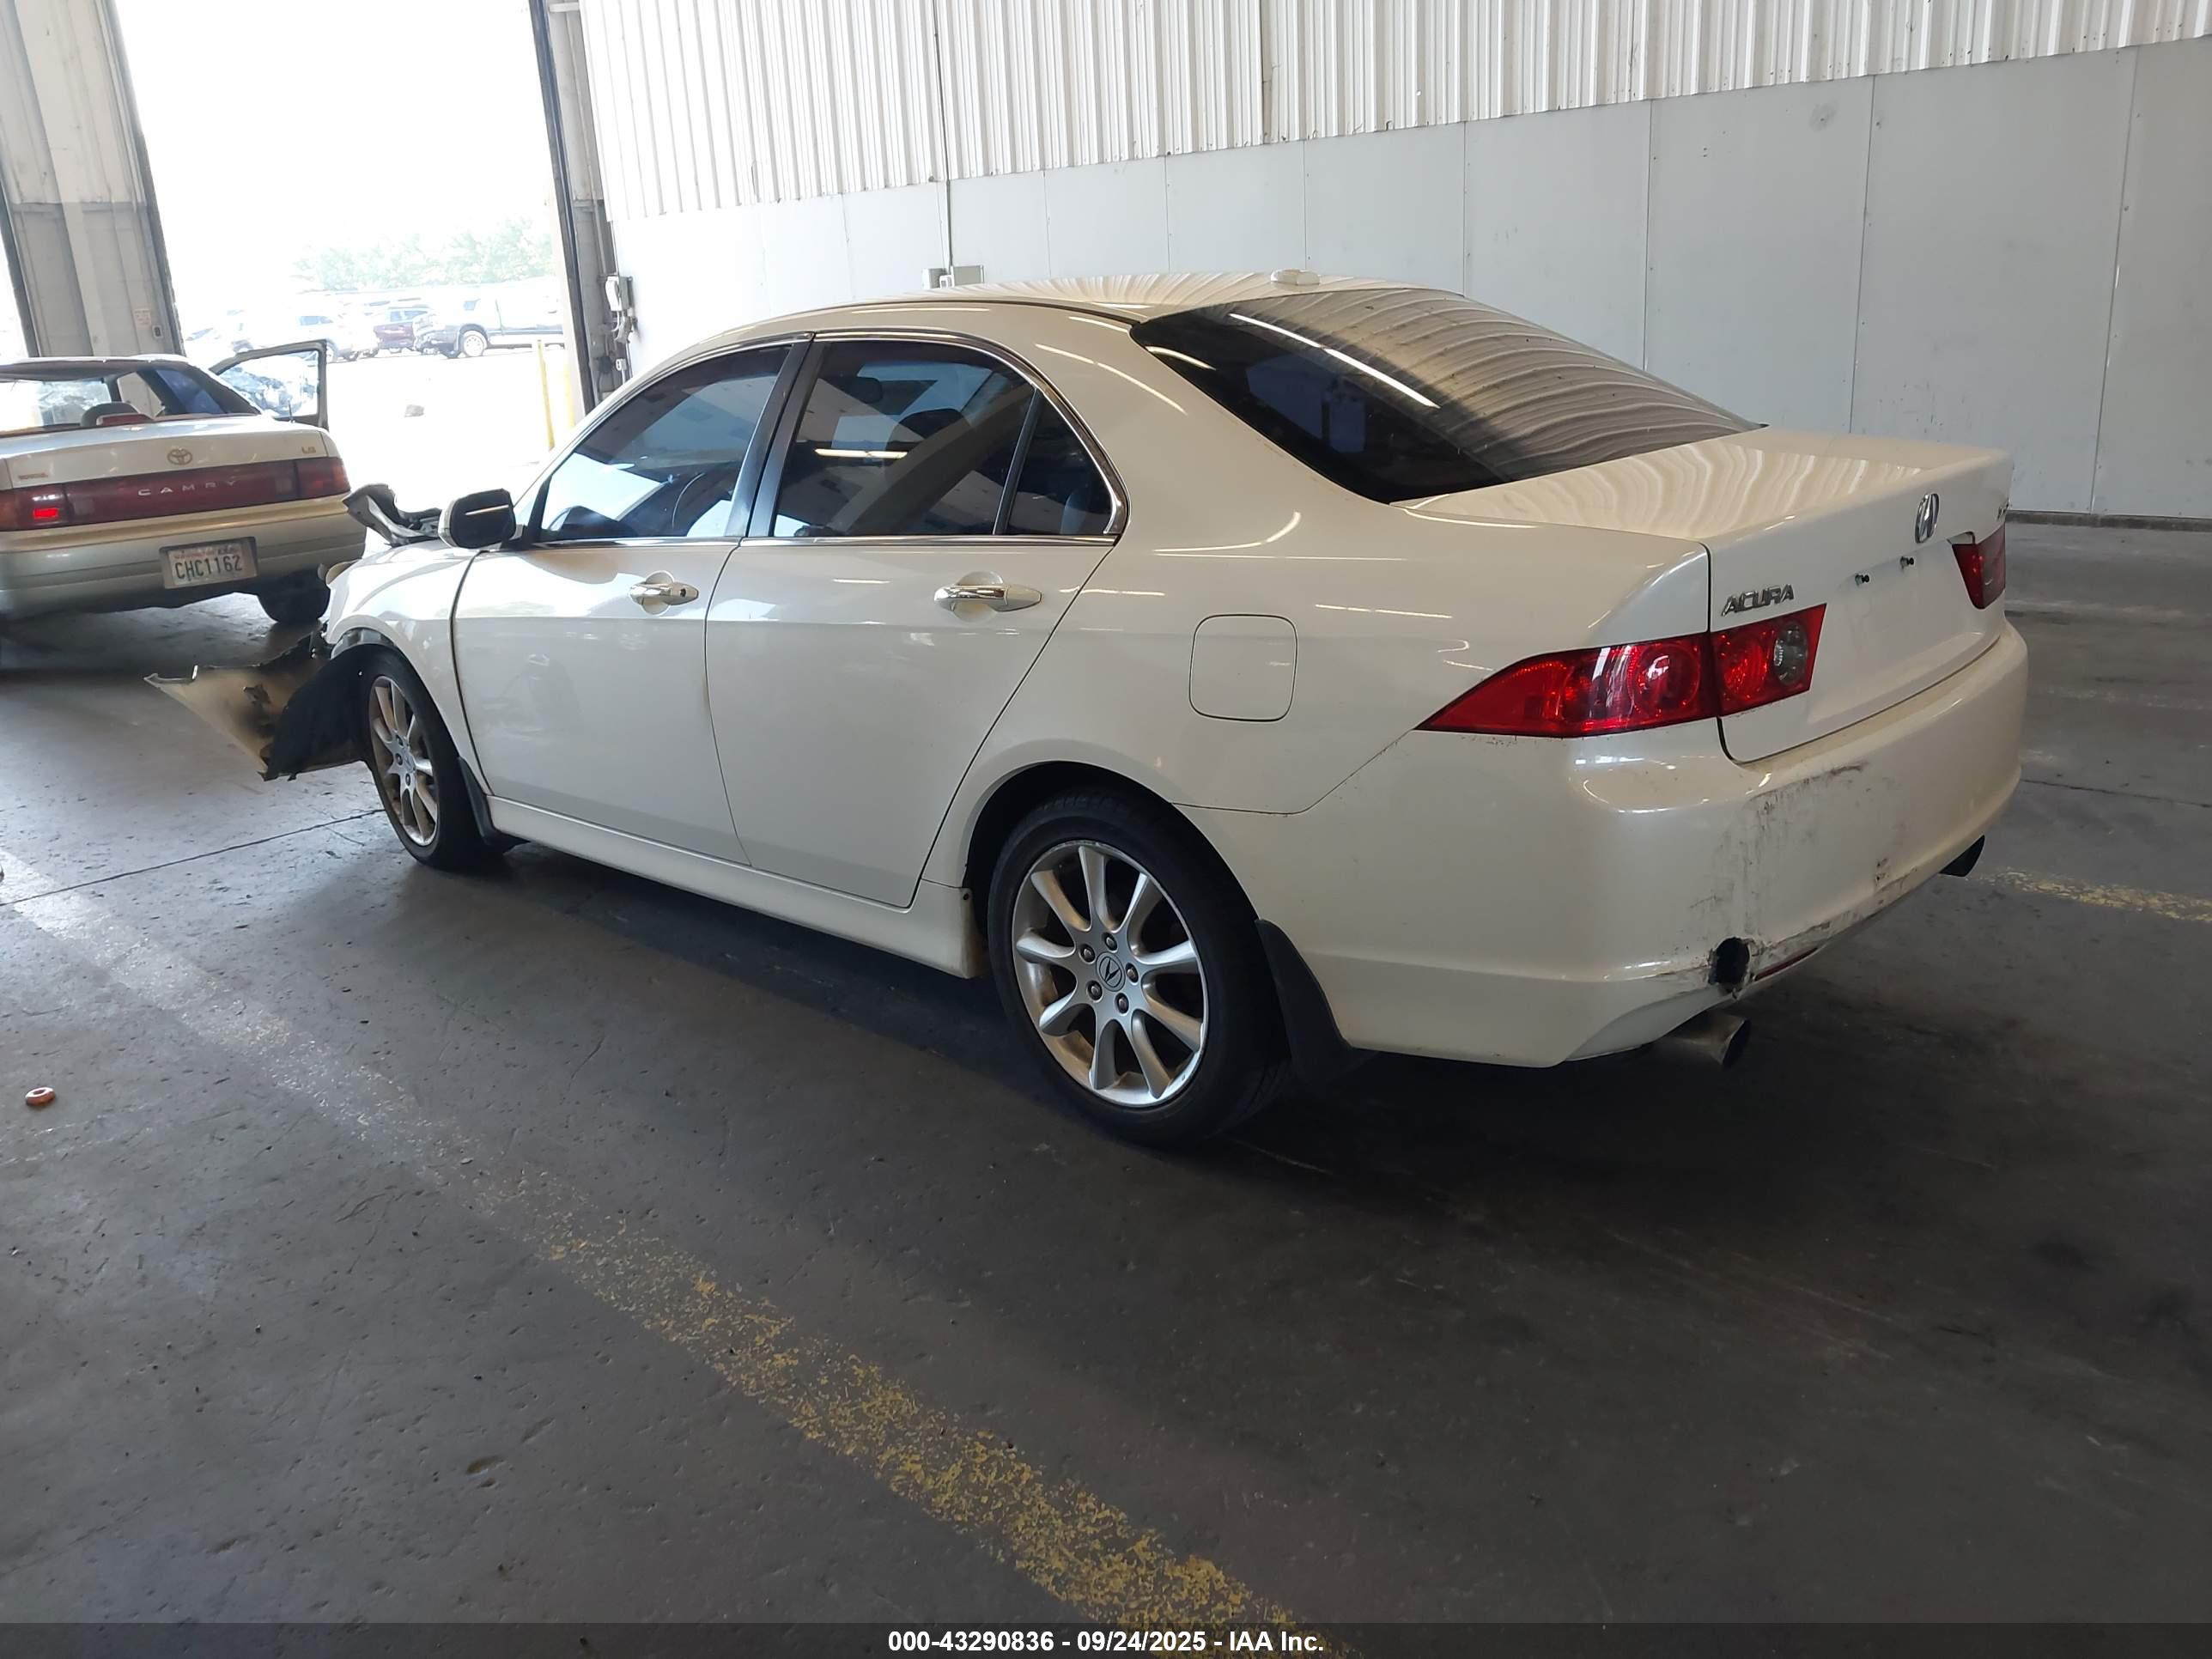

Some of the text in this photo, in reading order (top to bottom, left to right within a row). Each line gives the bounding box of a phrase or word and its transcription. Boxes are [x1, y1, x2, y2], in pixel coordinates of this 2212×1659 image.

[137, 476, 237, 496] CAMRY
[174, 555, 242, 580] CHC1162
[1721, 583, 1795, 617] ACURA
